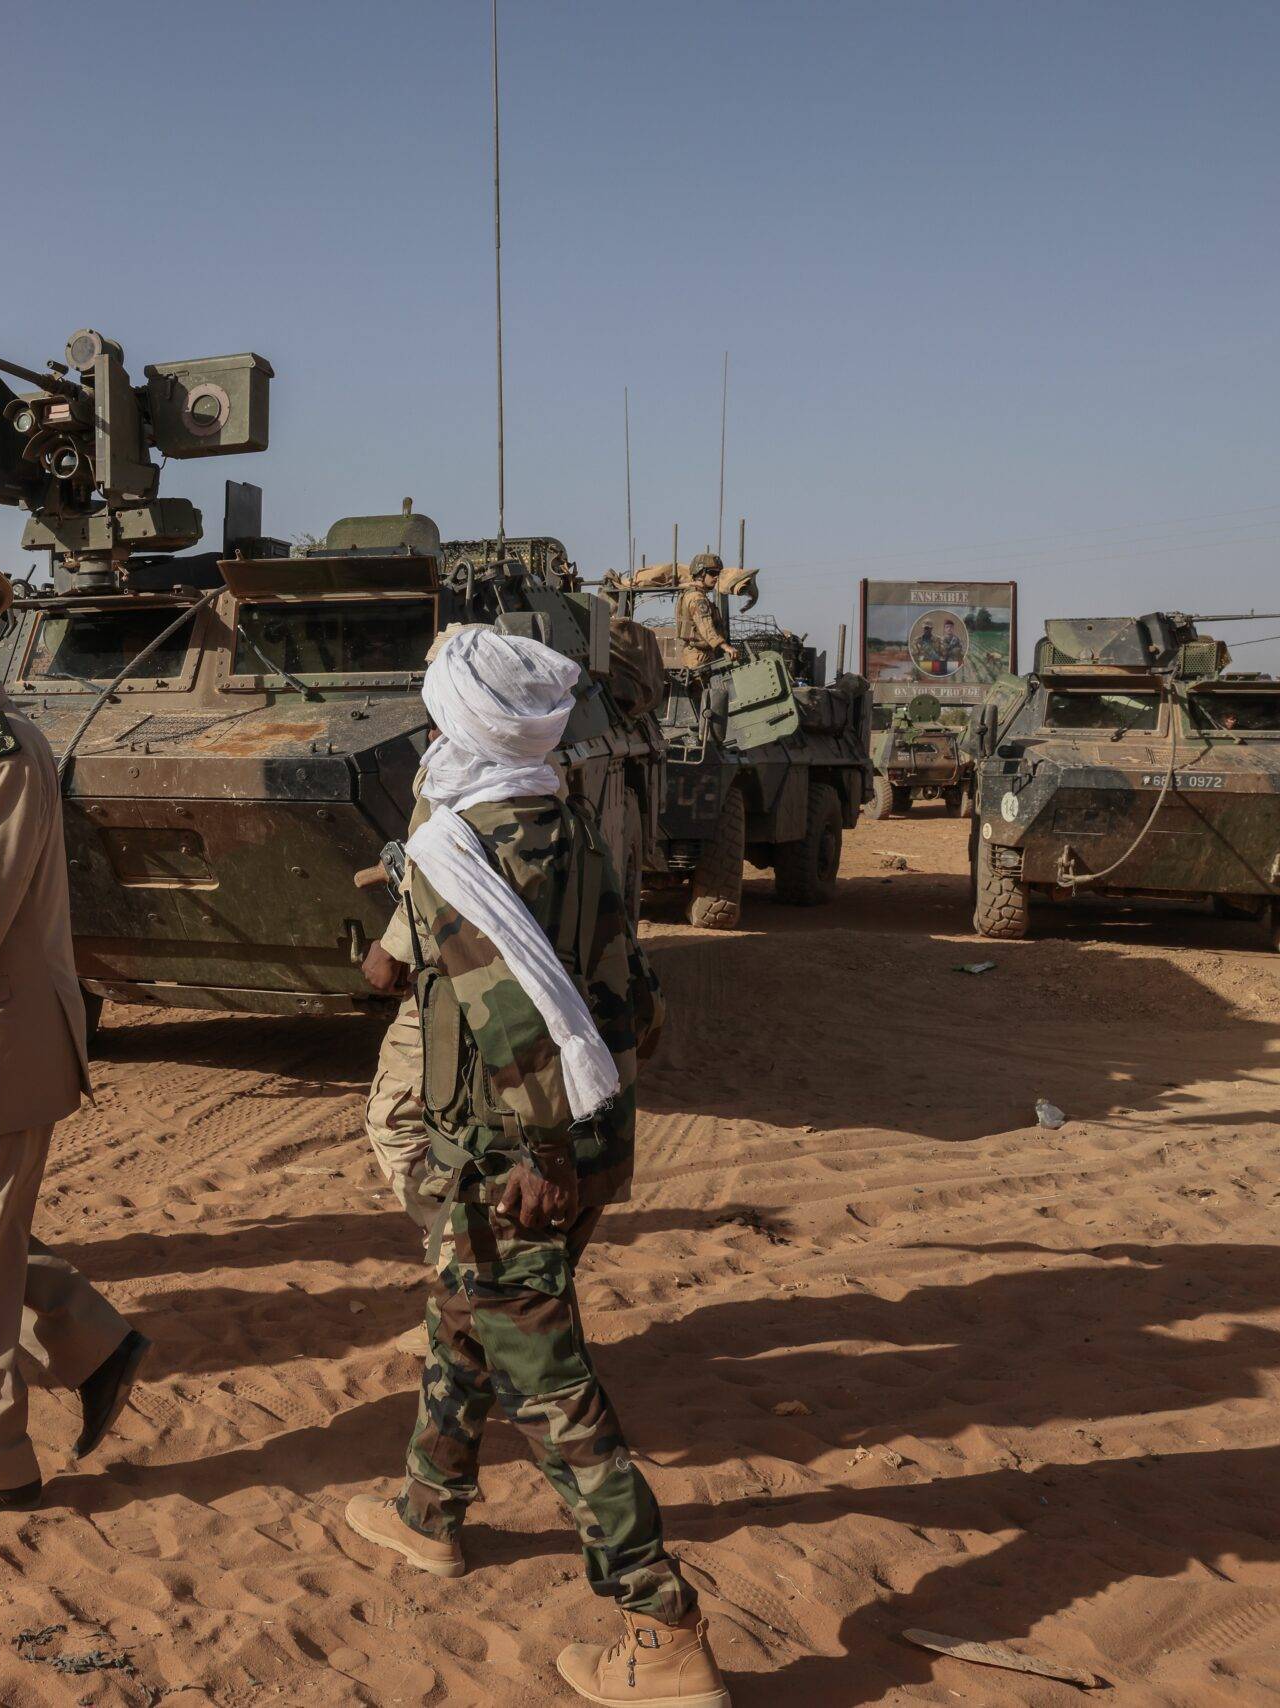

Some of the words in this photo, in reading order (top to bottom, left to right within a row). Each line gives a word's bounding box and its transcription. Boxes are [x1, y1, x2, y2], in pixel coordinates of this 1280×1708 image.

[910, 591, 969, 603] ENSEMBLE
[894, 687, 908, 696] ON
[1153, 775, 1182, 787] 683
[1189, 776, 1222, 788] 0972
